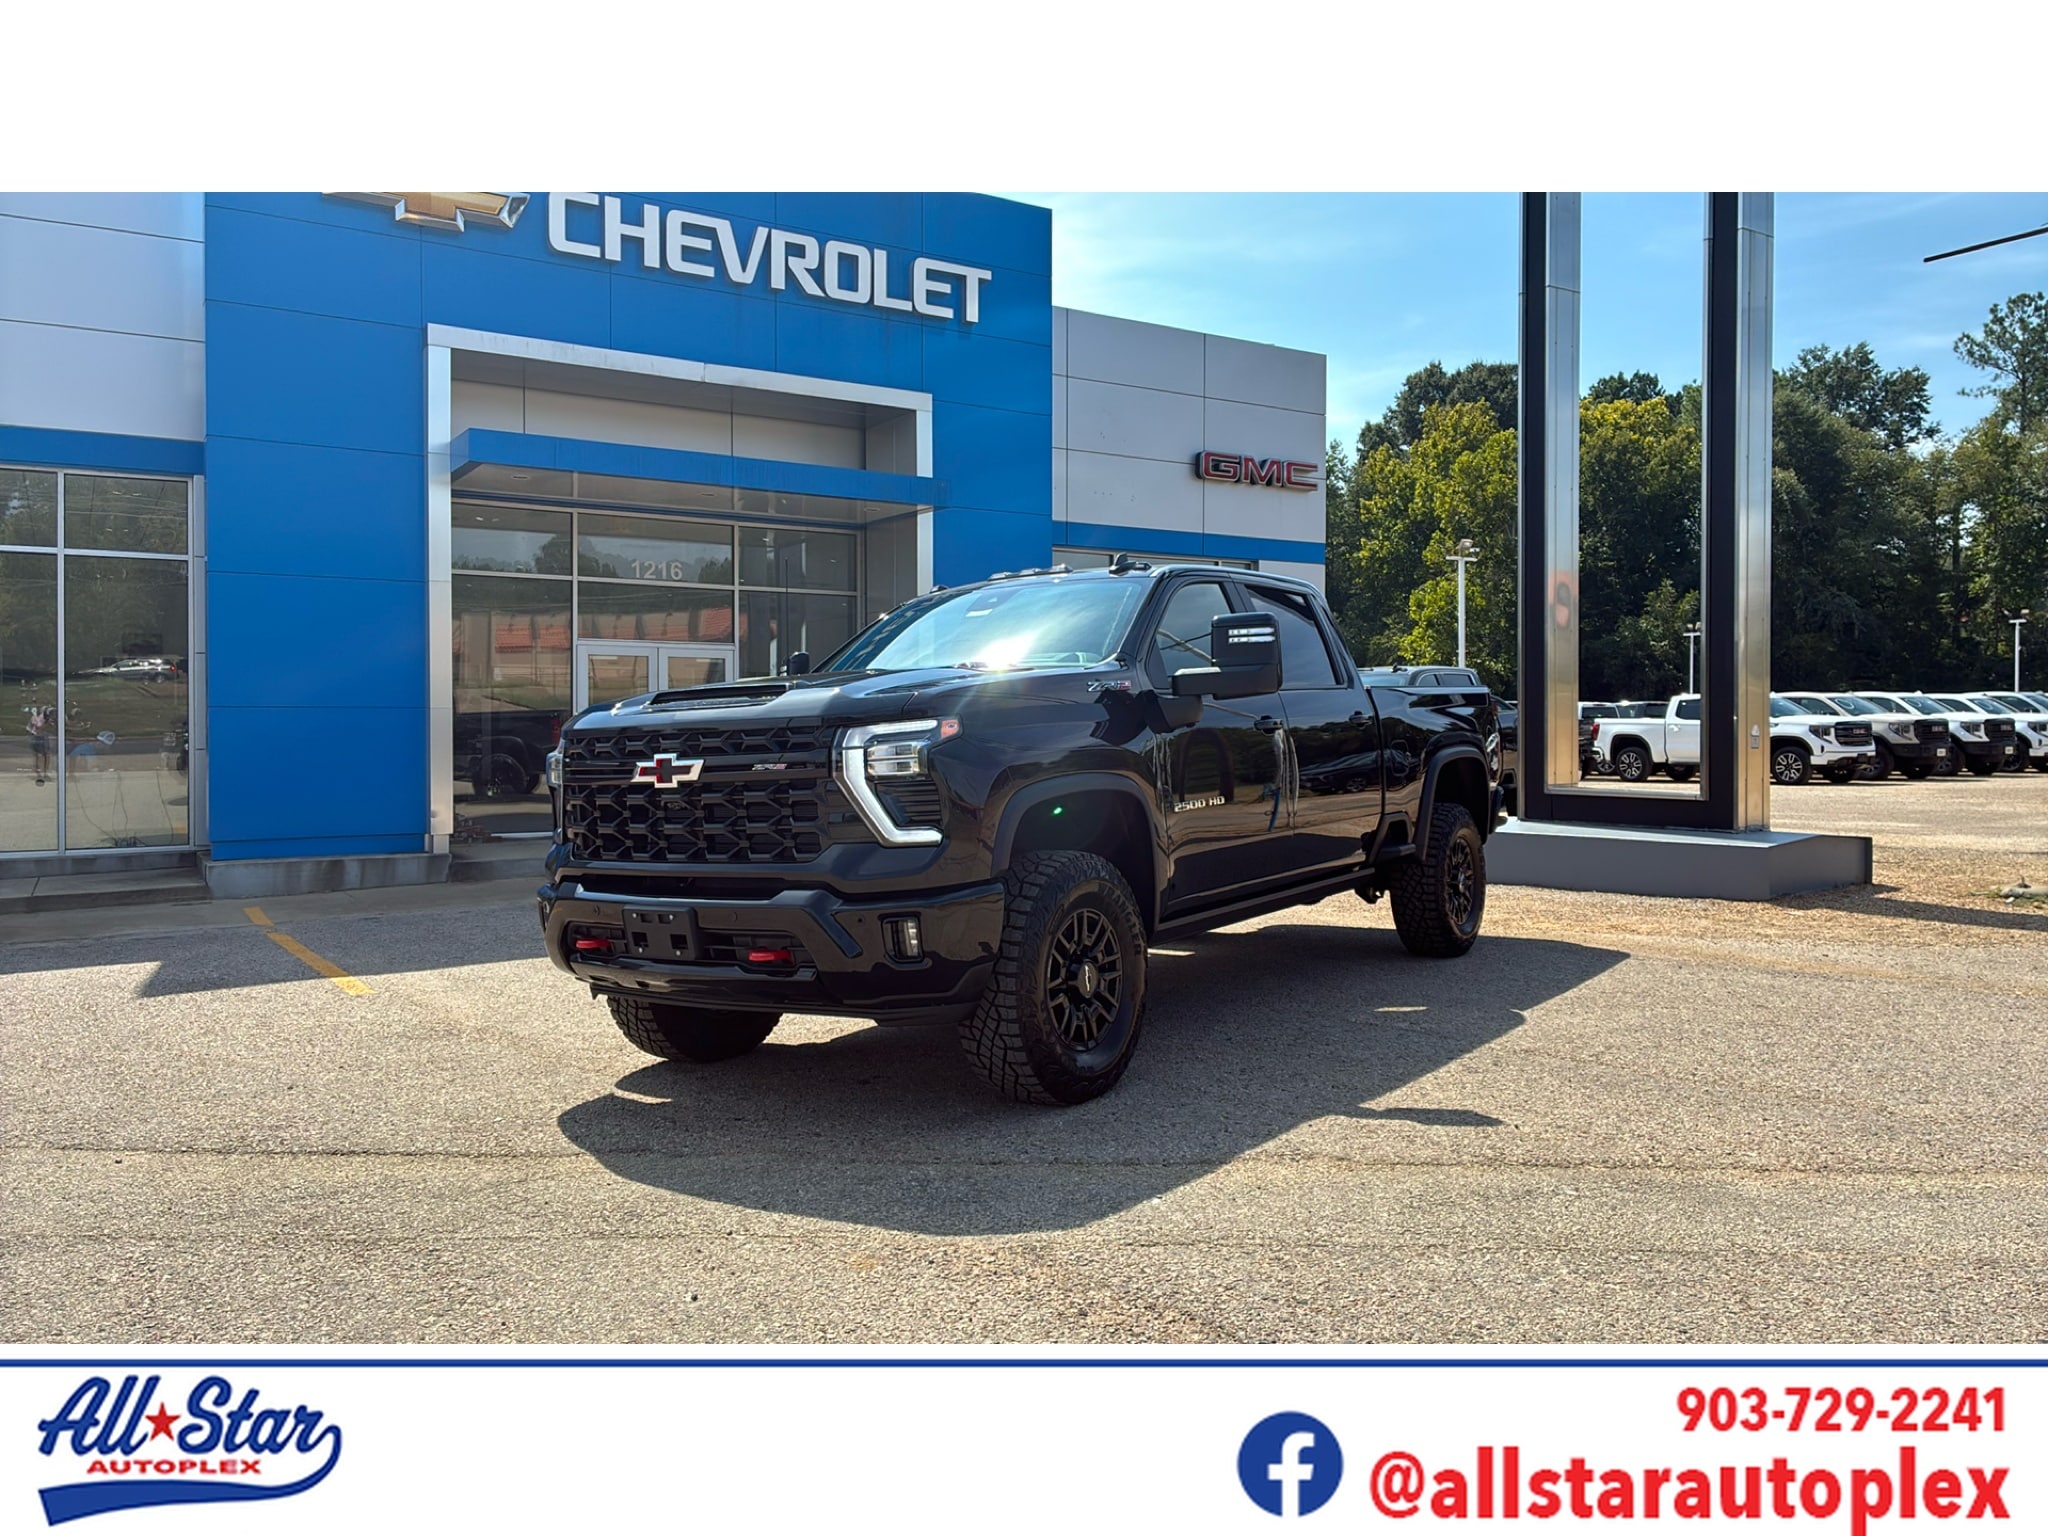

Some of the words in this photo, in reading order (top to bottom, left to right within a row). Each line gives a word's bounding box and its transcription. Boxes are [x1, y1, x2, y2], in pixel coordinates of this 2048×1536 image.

[547, 192, 992, 323] CHEVROLET
[1197, 450, 1319, 490] GMC
[631, 560, 682, 580] 1216
[1174, 798, 1206, 812] 2500
[1209, 795, 1226, 806] HD
